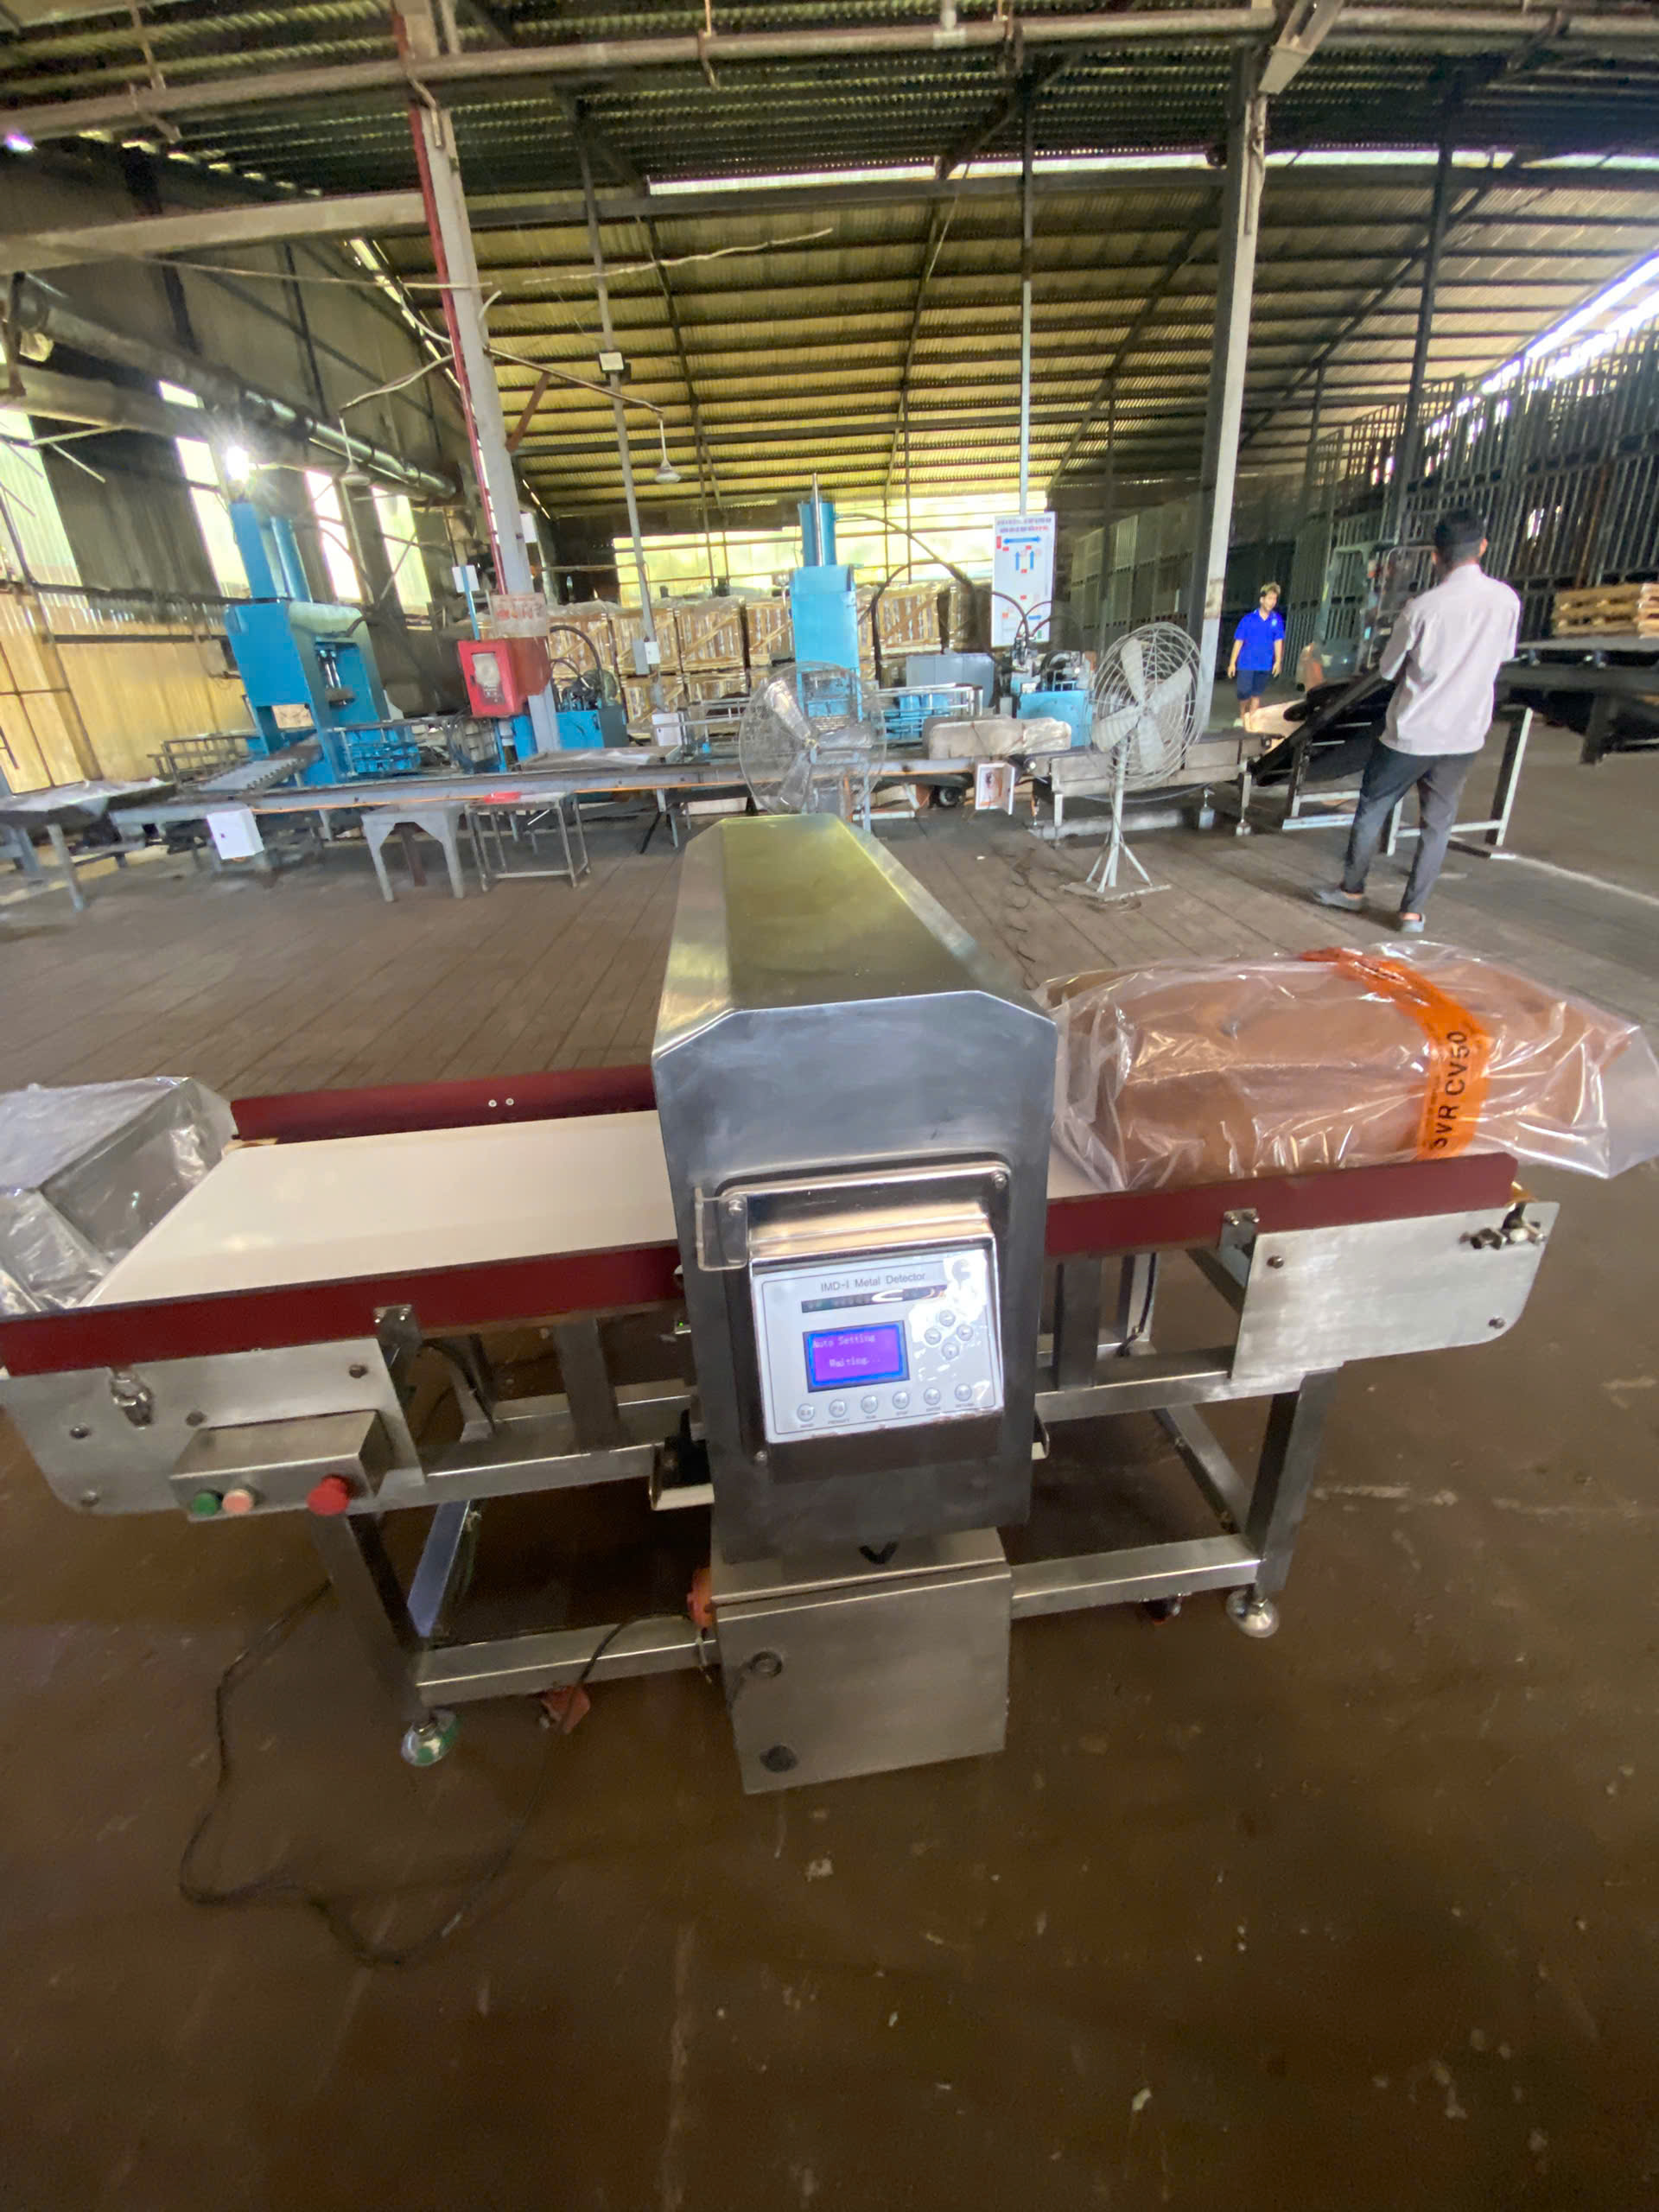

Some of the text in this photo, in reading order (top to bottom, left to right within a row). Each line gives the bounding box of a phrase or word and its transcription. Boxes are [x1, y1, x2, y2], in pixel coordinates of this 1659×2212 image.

[1446, 1031, 1469, 1096] CV50
[855, 1276, 880, 1288] Metal
[886, 1272, 926, 1285] Detector
[813, 1333, 875, 1349] Auto Setting
